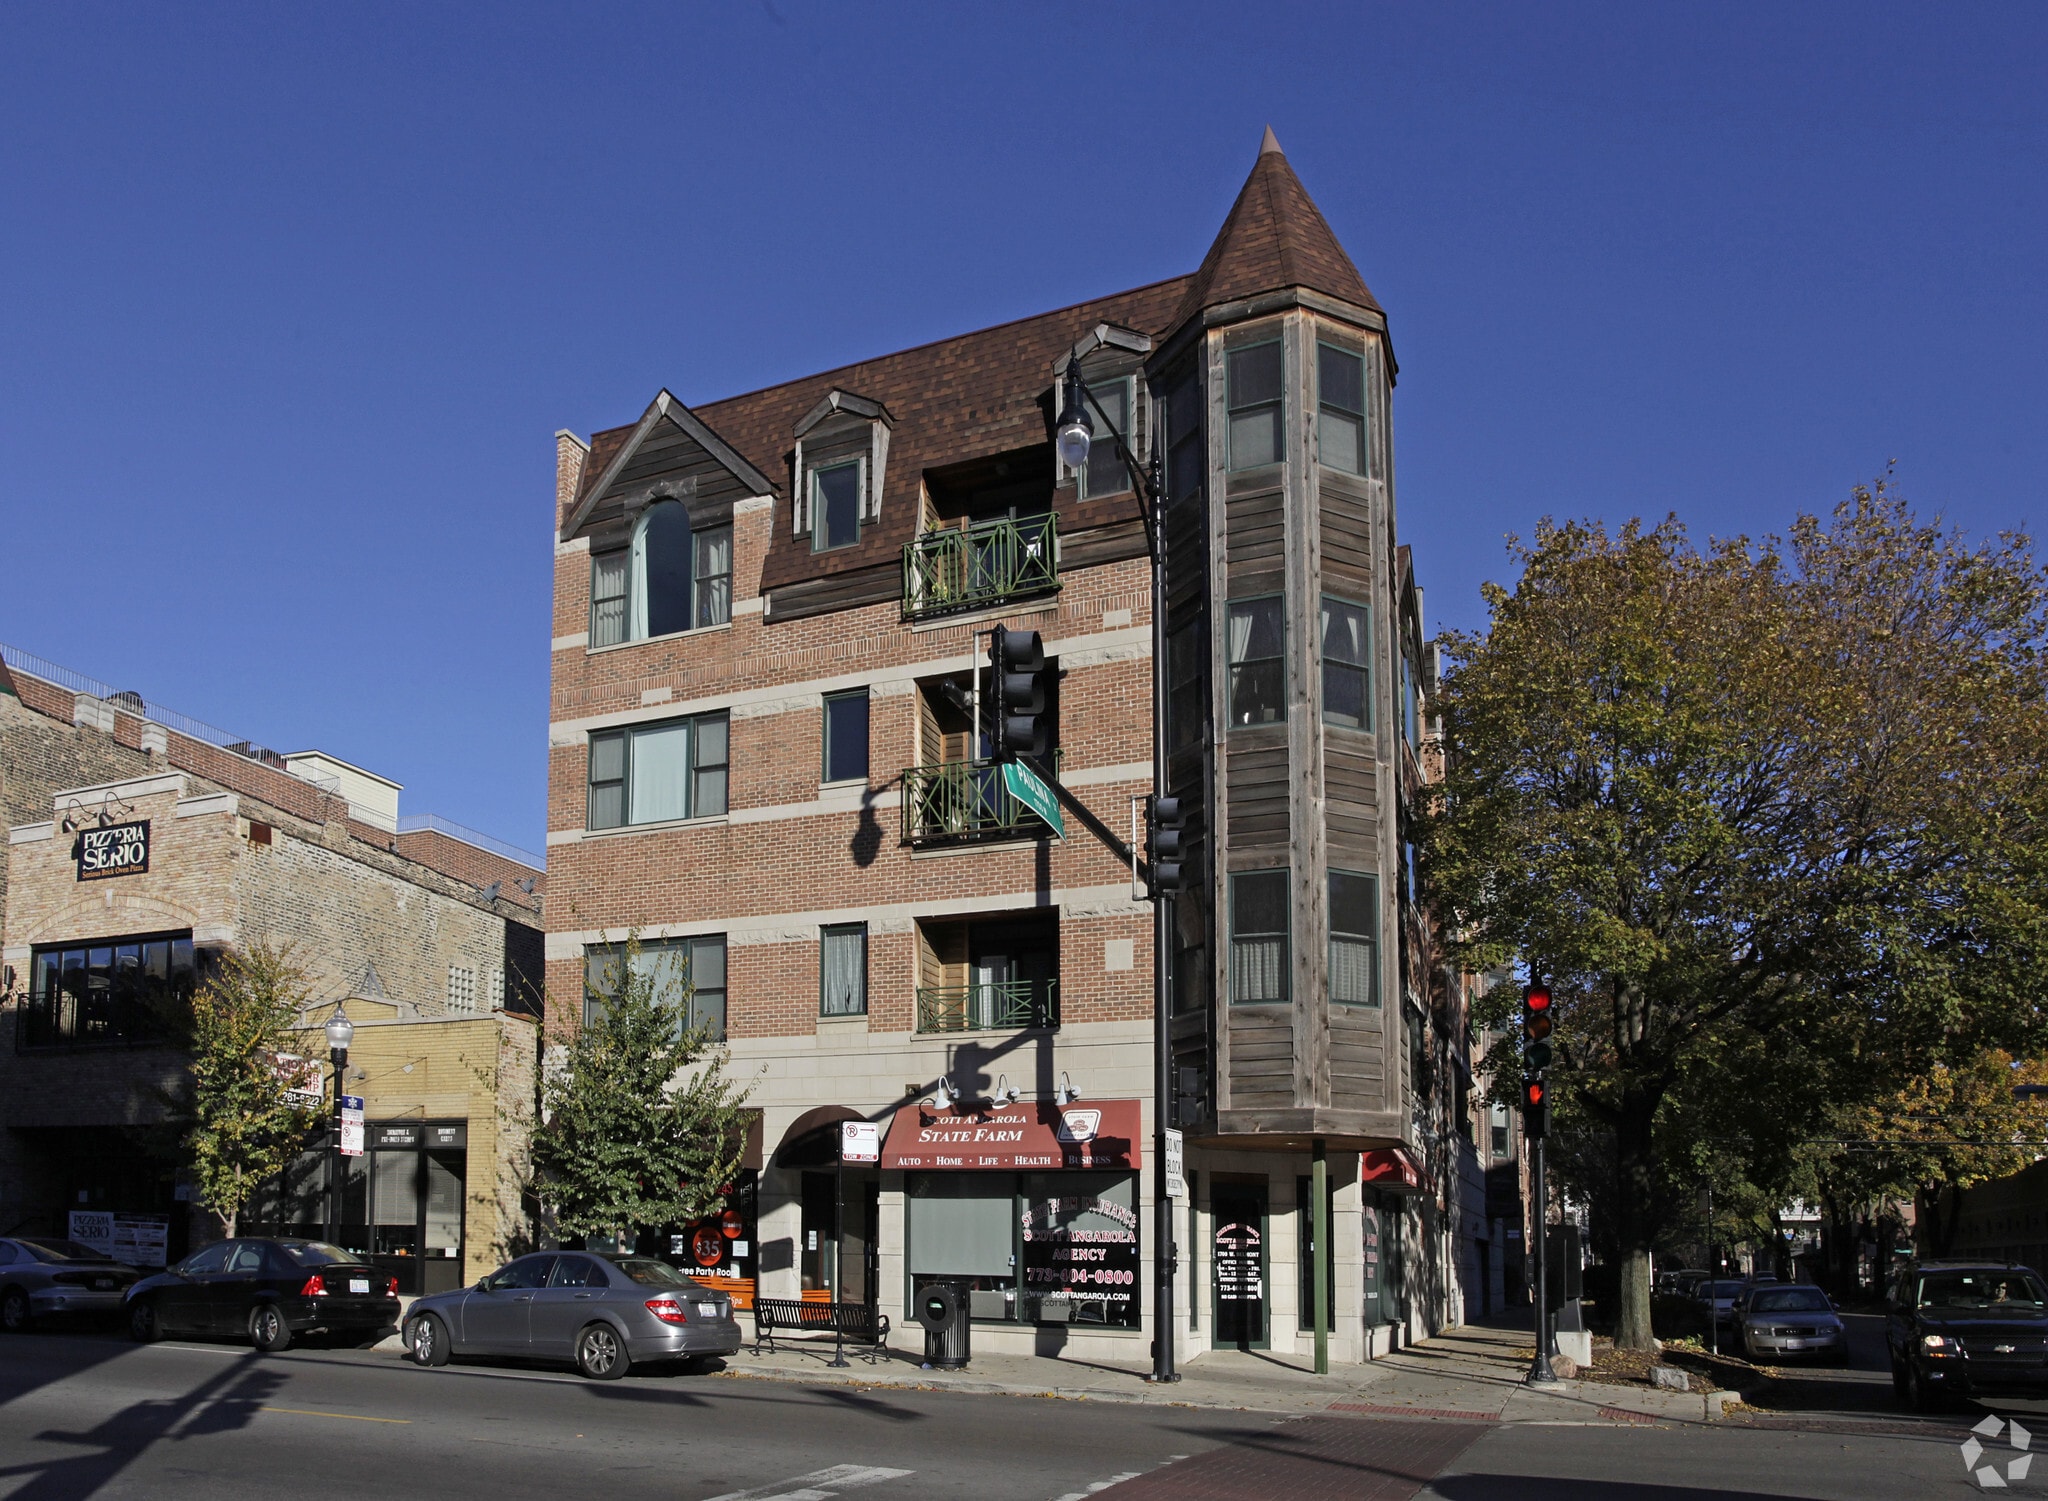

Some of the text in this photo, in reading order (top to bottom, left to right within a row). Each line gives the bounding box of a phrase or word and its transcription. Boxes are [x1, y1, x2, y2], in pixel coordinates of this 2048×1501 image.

[1016, 764, 1050, 808] PAULINA
[84, 826, 144, 848] PIZZERIA
[83, 842, 144, 869] SERIO
[923, 1115, 1027, 1125] SCOTT ANGAROLA
[918, 1129, 1024, 1142] STATE FARM
[898, 1154, 1111, 1165] AUTO HOME LIFE HEALTH BUSINESS
[1168, 1158, 1182, 1175] BLOCK
[1082, 1197, 1136, 1228] INSURANCE
[73, 1215, 110, 1226] PIZZERIA
[72, 1226, 110, 1239] SERIO
[1023, 1228, 1136, 1243] SCOTT ANGAROLA
[696, 1239, 720, 1258] $35
[1052, 1248, 1107, 1261] AGENCY
[695, 1267, 715, 1277] Party
[717, 1267, 731, 1277] Roo
[1027, 1267, 1133, 1284] 773-404-0800
[731, 1296, 743, 1308] Spa
